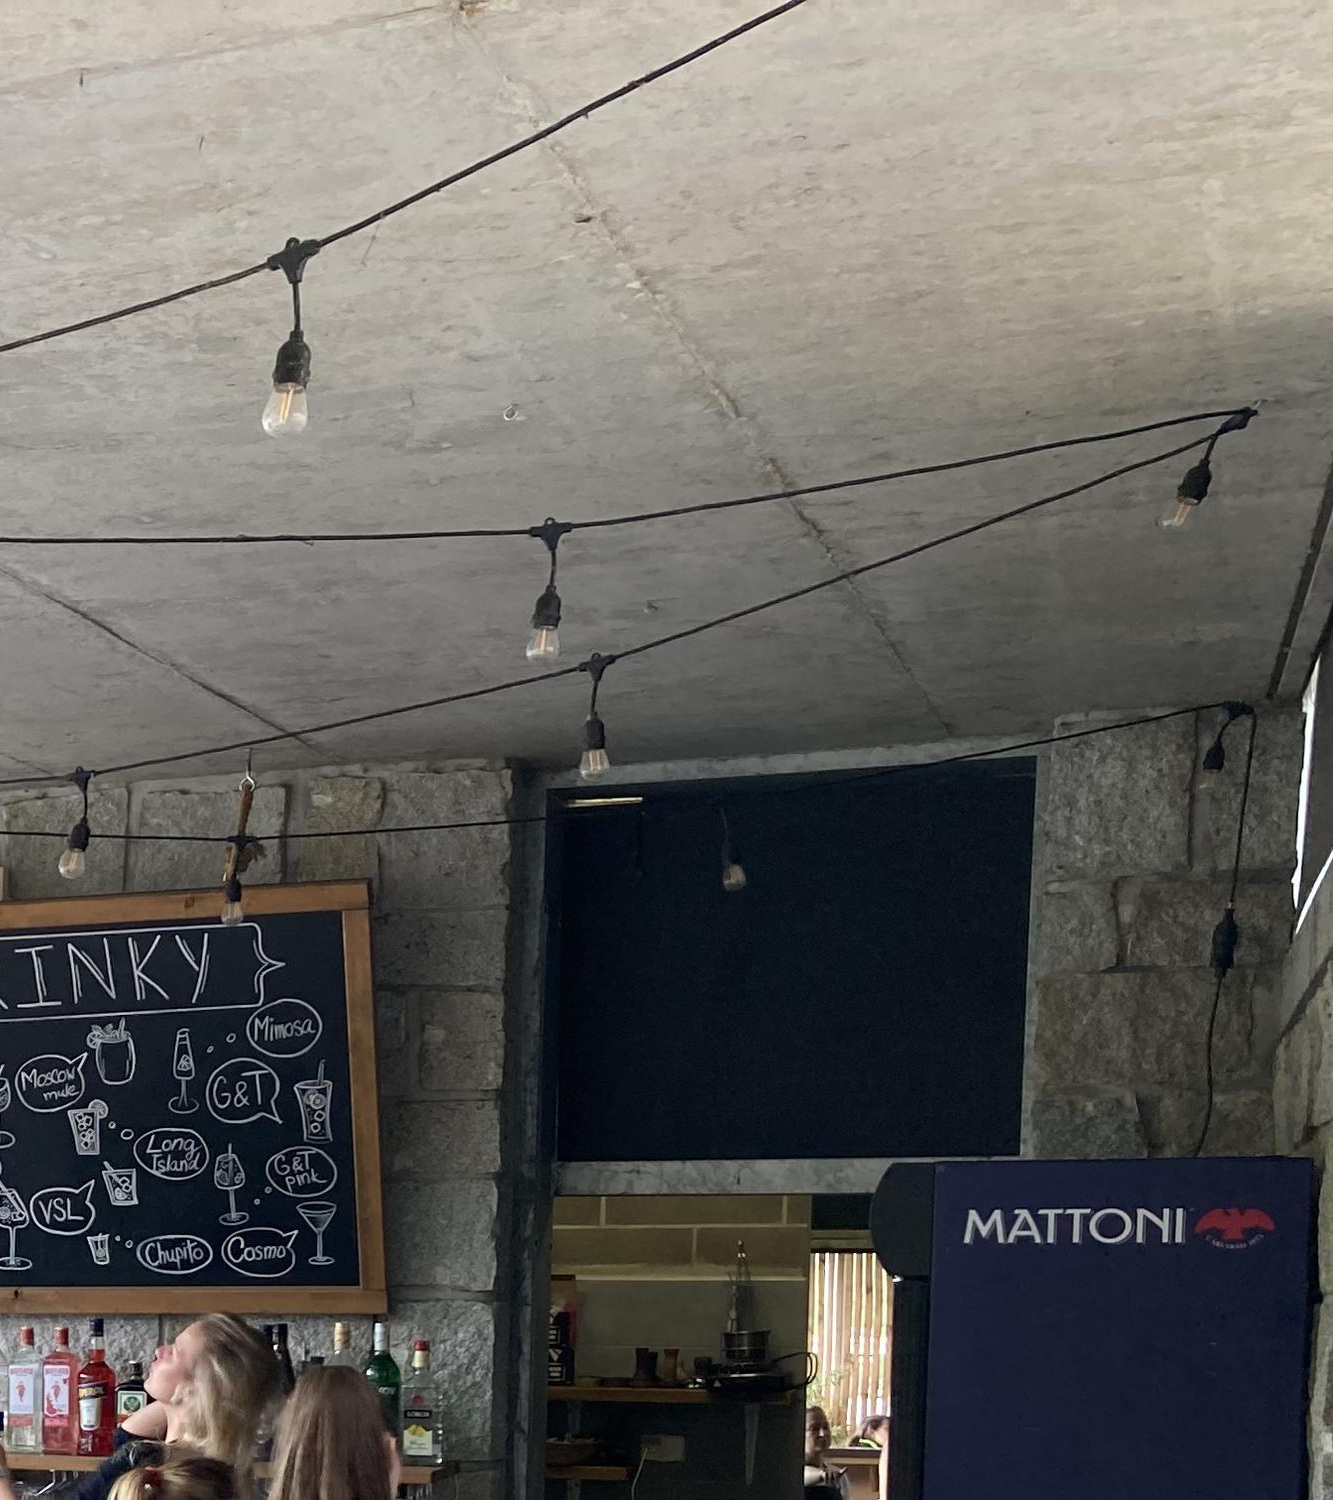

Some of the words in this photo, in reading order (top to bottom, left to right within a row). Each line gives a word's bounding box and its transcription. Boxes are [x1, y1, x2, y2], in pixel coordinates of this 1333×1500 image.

[253, 1016, 316, 1042] Mimosa
[21, 1066, 76, 1091] Moscow
[42, 1083, 79, 1100] mule
[213, 1070, 270, 1108] G&T
[146, 1134, 202, 1160] Long
[151, 1153, 202, 1173] Island
[274, 1150, 317, 1175] G&T
[285, 1172, 328, 1193] pink
[37, 1197, 85, 1224] VSL
[963, 1206, 1187, 1245] MATTONI
[145, 1239, 205, 1270] Chupito
[227, 1236, 286, 1263] Cosmo
